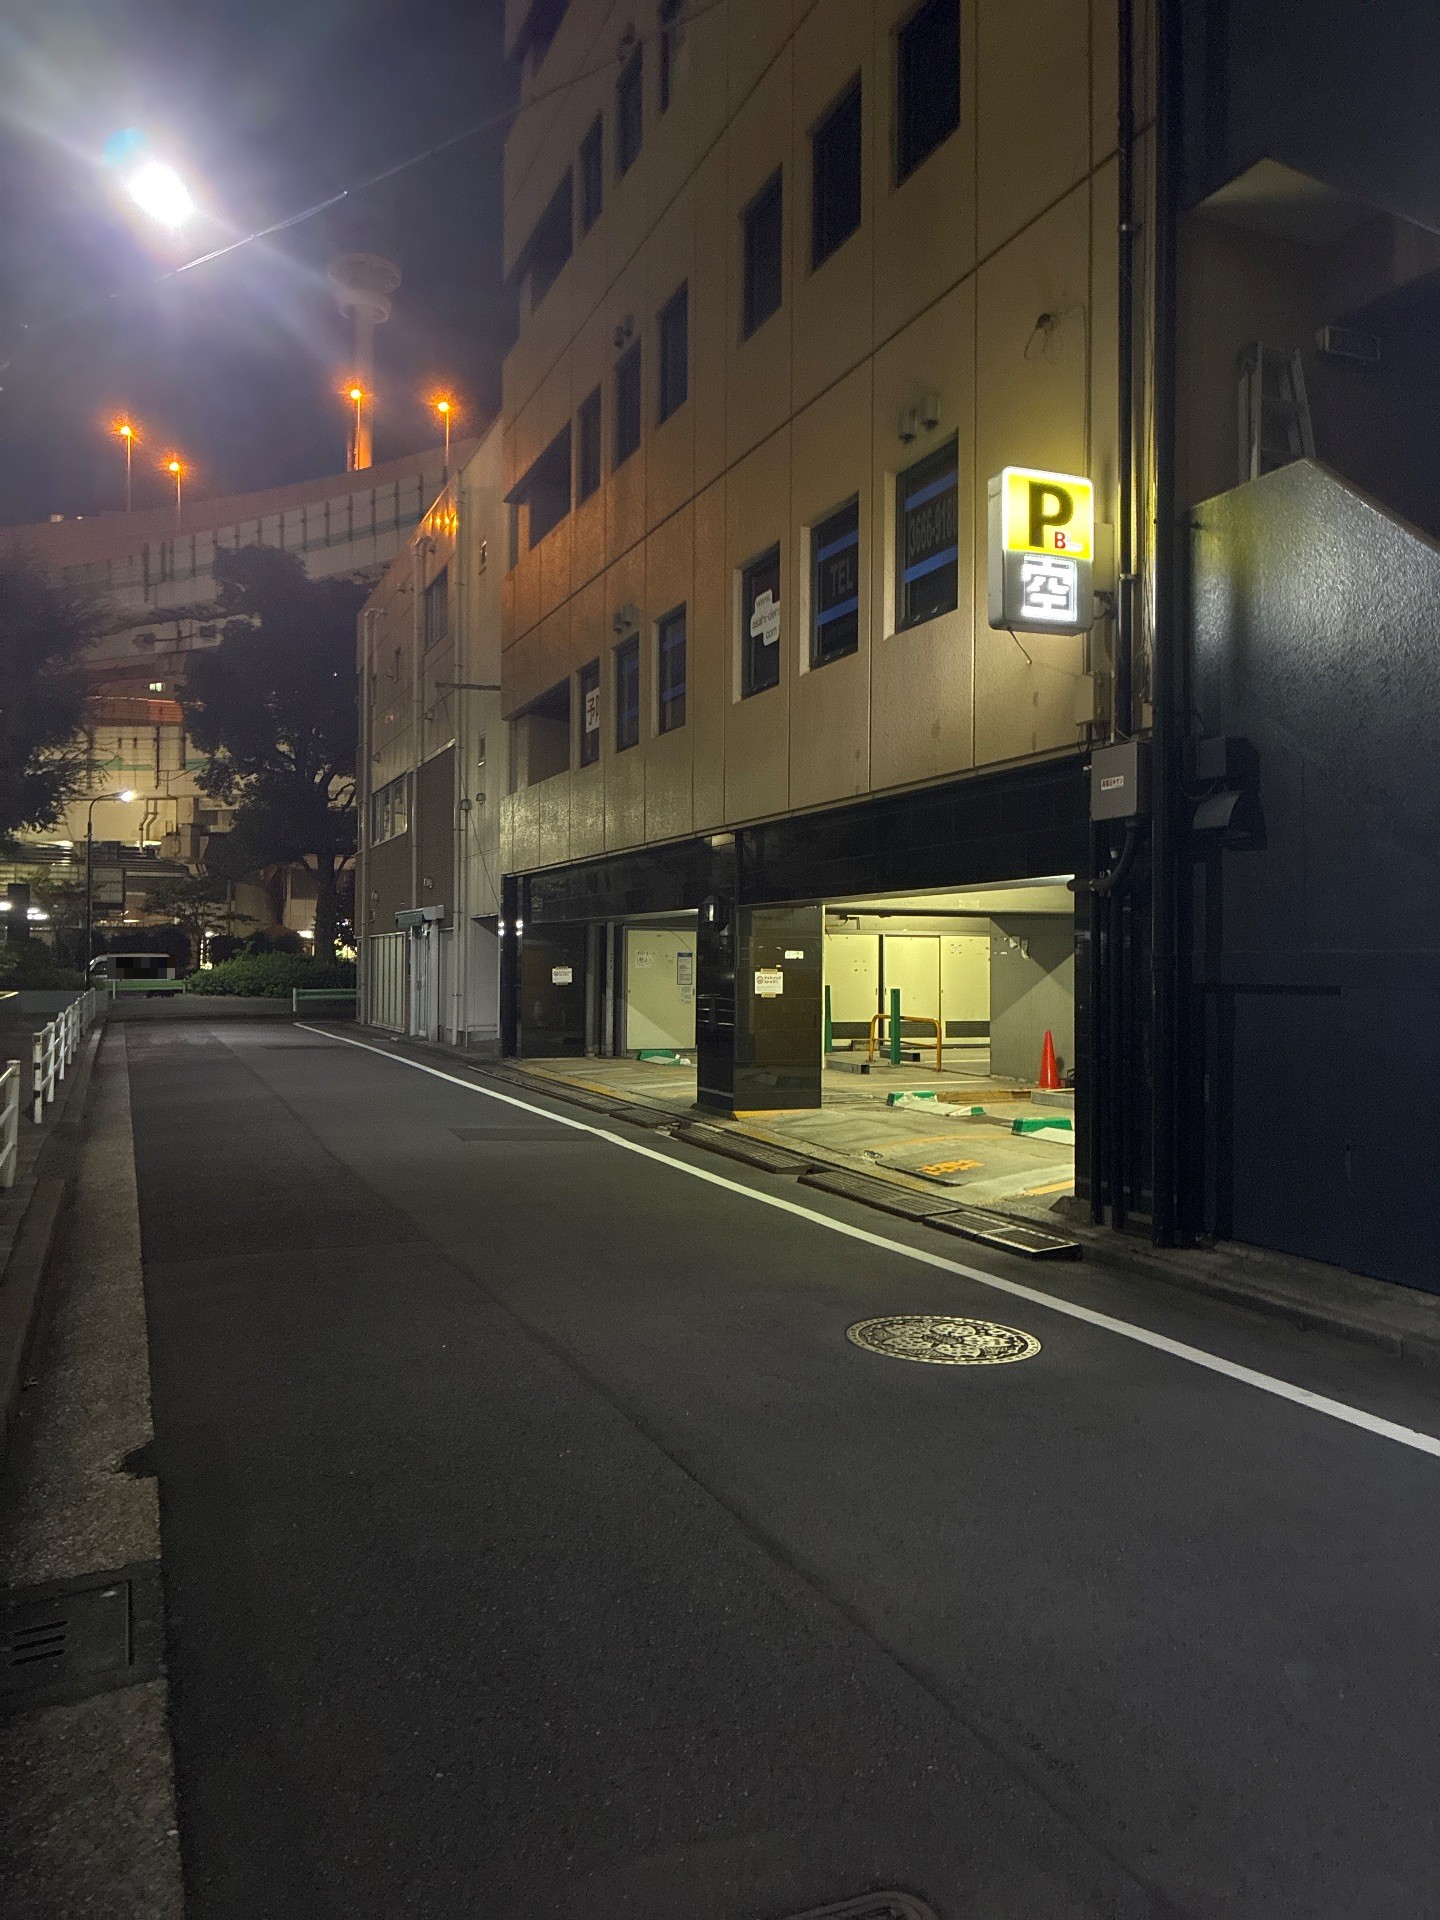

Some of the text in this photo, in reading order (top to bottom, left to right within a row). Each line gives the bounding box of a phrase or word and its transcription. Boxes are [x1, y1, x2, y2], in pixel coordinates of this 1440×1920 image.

[1029, 480, 1074, 548] P
[1055, 531, 1066, 549] B
[830, 558, 854, 598] TEL
[1021, 557, 1076, 621] 空
